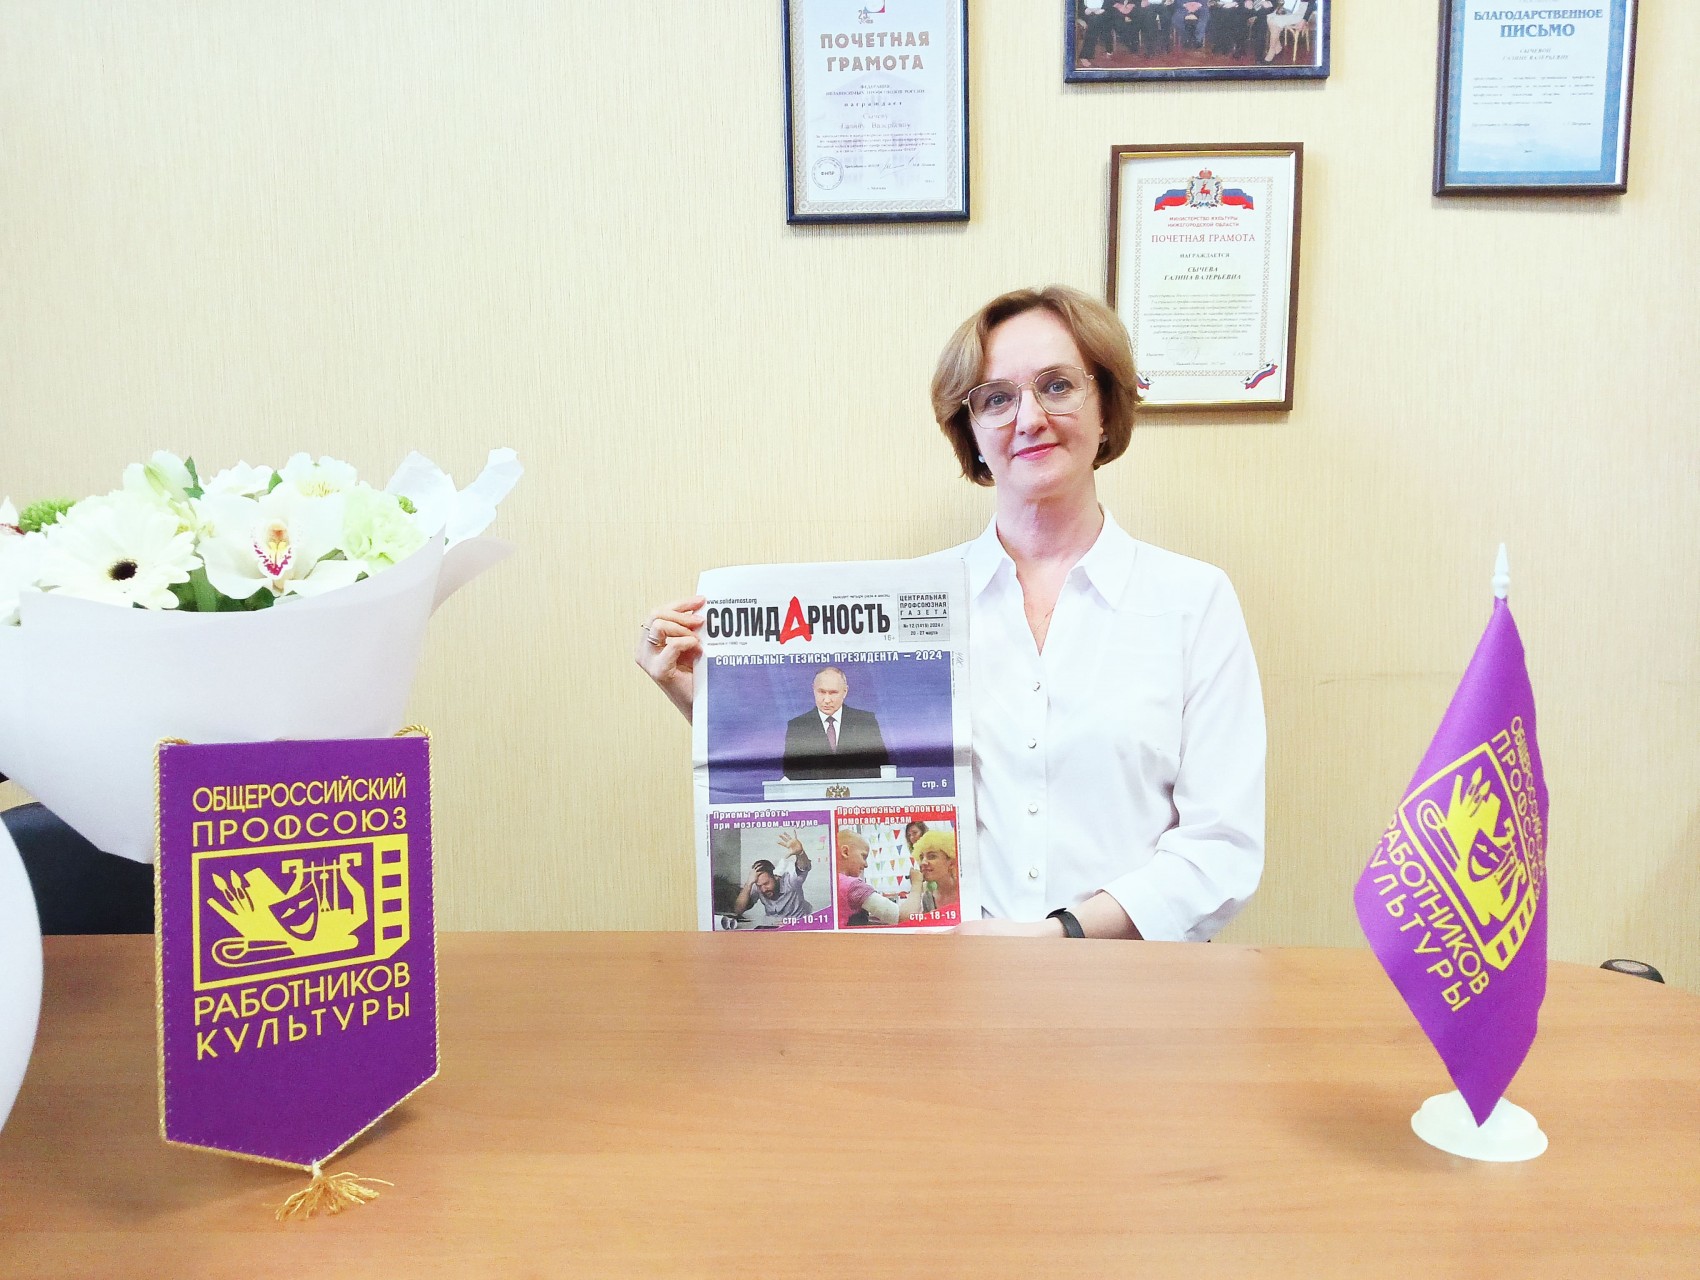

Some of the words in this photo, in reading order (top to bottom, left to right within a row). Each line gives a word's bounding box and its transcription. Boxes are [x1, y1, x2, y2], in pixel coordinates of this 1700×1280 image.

[1474, 9, 1603, 21] БЛАГОДАРСТВЕННОЕ
[1500, 23, 1575, 38] ПИСЬМО
[820, 31, 930, 49] ПОЧЕТНАЯ
[826, 55, 924, 72] ГРАМОТА
[1151, 234, 1205, 243] ПОЧЕТНАЯ
[1208, 233, 1256, 242] ГРАМОТА
[706, 596, 891, 645] СОЛИДАРНОСТЬ
[715, 654, 785, 666] СОЦИАЛЬНЫЕ
[790, 653, 830, 664] ТЕЗИСЫ
[834, 652, 899, 664] ПРЕЗИДЕНТА
[915, 650, 943, 660] 2024
[921, 780, 938, 790] стр.
[941, 779, 948, 788] 6
[192, 772, 406, 813] ОБЩЕРОССИЙСКИЙ
[713, 810, 751, 820] Приемы
[754, 809, 790, 820] работы
[837, 806, 900, 816] Профсоюзные
[904, 804, 954, 814] волонтеры
[192, 806, 407, 847] ПРОФСОЮЗ
[713, 822, 730, 830] при
[733, 821, 779, 829] мозговом
[782, 820, 818, 828] штурме
[837, 816, 881, 825] помогают
[884, 816, 912, 825] детям
[782, 917, 800, 926] стр.
[802, 914, 828, 924] 10-11
[909, 913, 926, 922] стр.
[930, 910, 956, 920] 18-19
[1370, 840, 1471, 1012] УЛЬТУРЫ
[193, 961, 411, 1026] РАБОТНИКОВ
[196, 992, 410, 1061] КУЛЬТУРЫ
